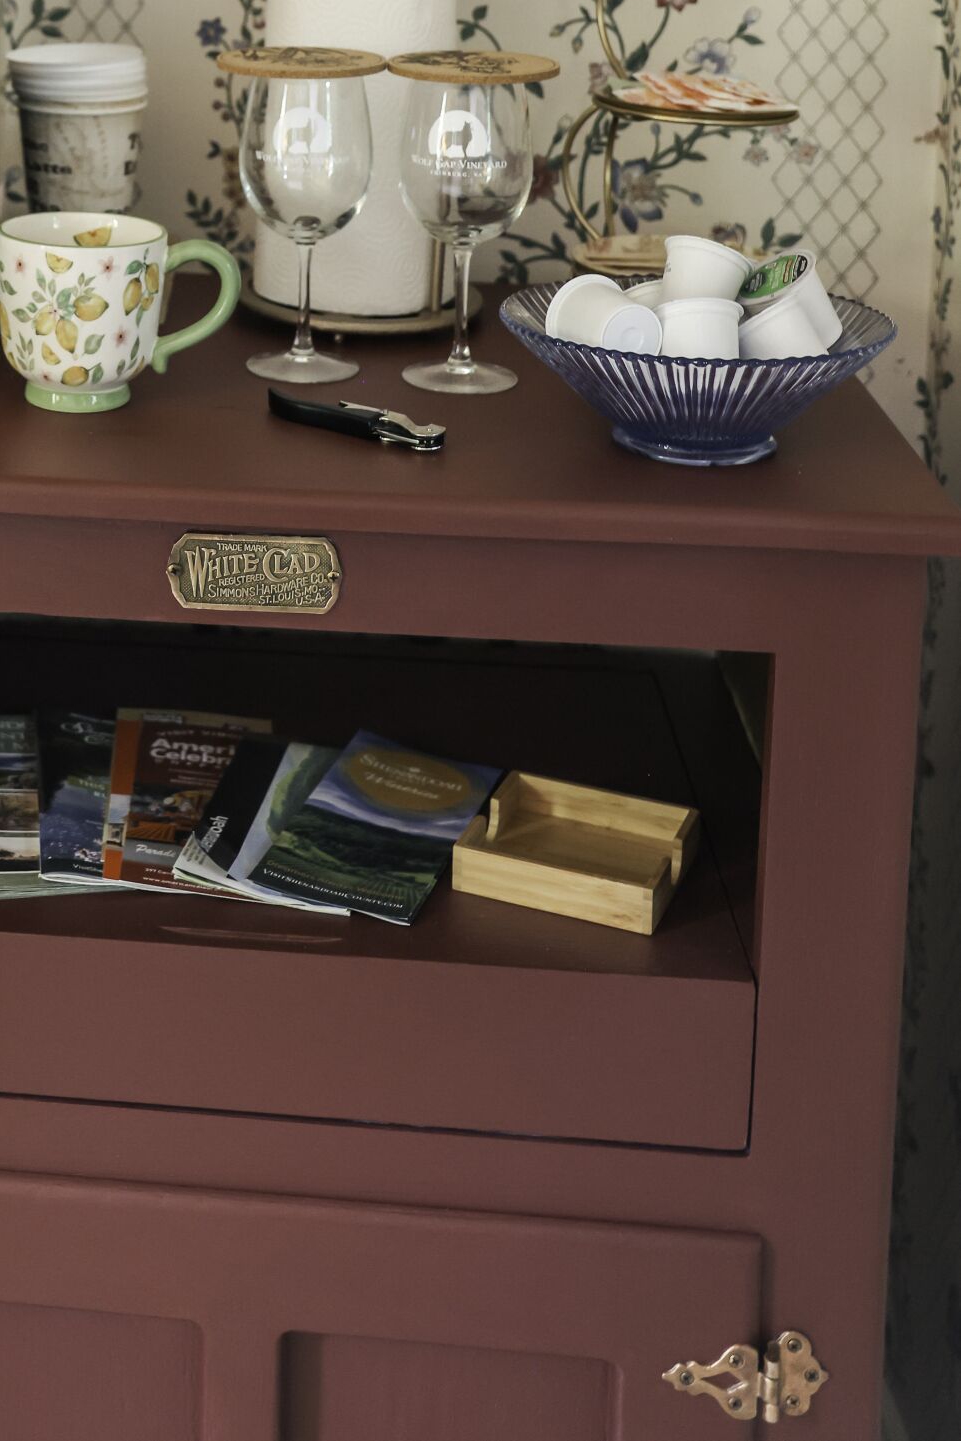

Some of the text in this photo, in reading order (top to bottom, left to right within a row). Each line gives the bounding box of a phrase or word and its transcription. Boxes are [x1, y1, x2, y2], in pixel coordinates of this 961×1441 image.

[435, 157, 456, 169] GAP
[458, 159, 508, 169] VINEYARD
[217, 542, 267, 552] TRADE MARK
[184, 546, 321, 598] WHITE CLAD
[218, 573, 265, 586] REGISTERED
[208, 584, 256, 598] SIMMONS
[256, 576, 309, 596] HARDWARE
[149, 747, 231, 765] Celebr
